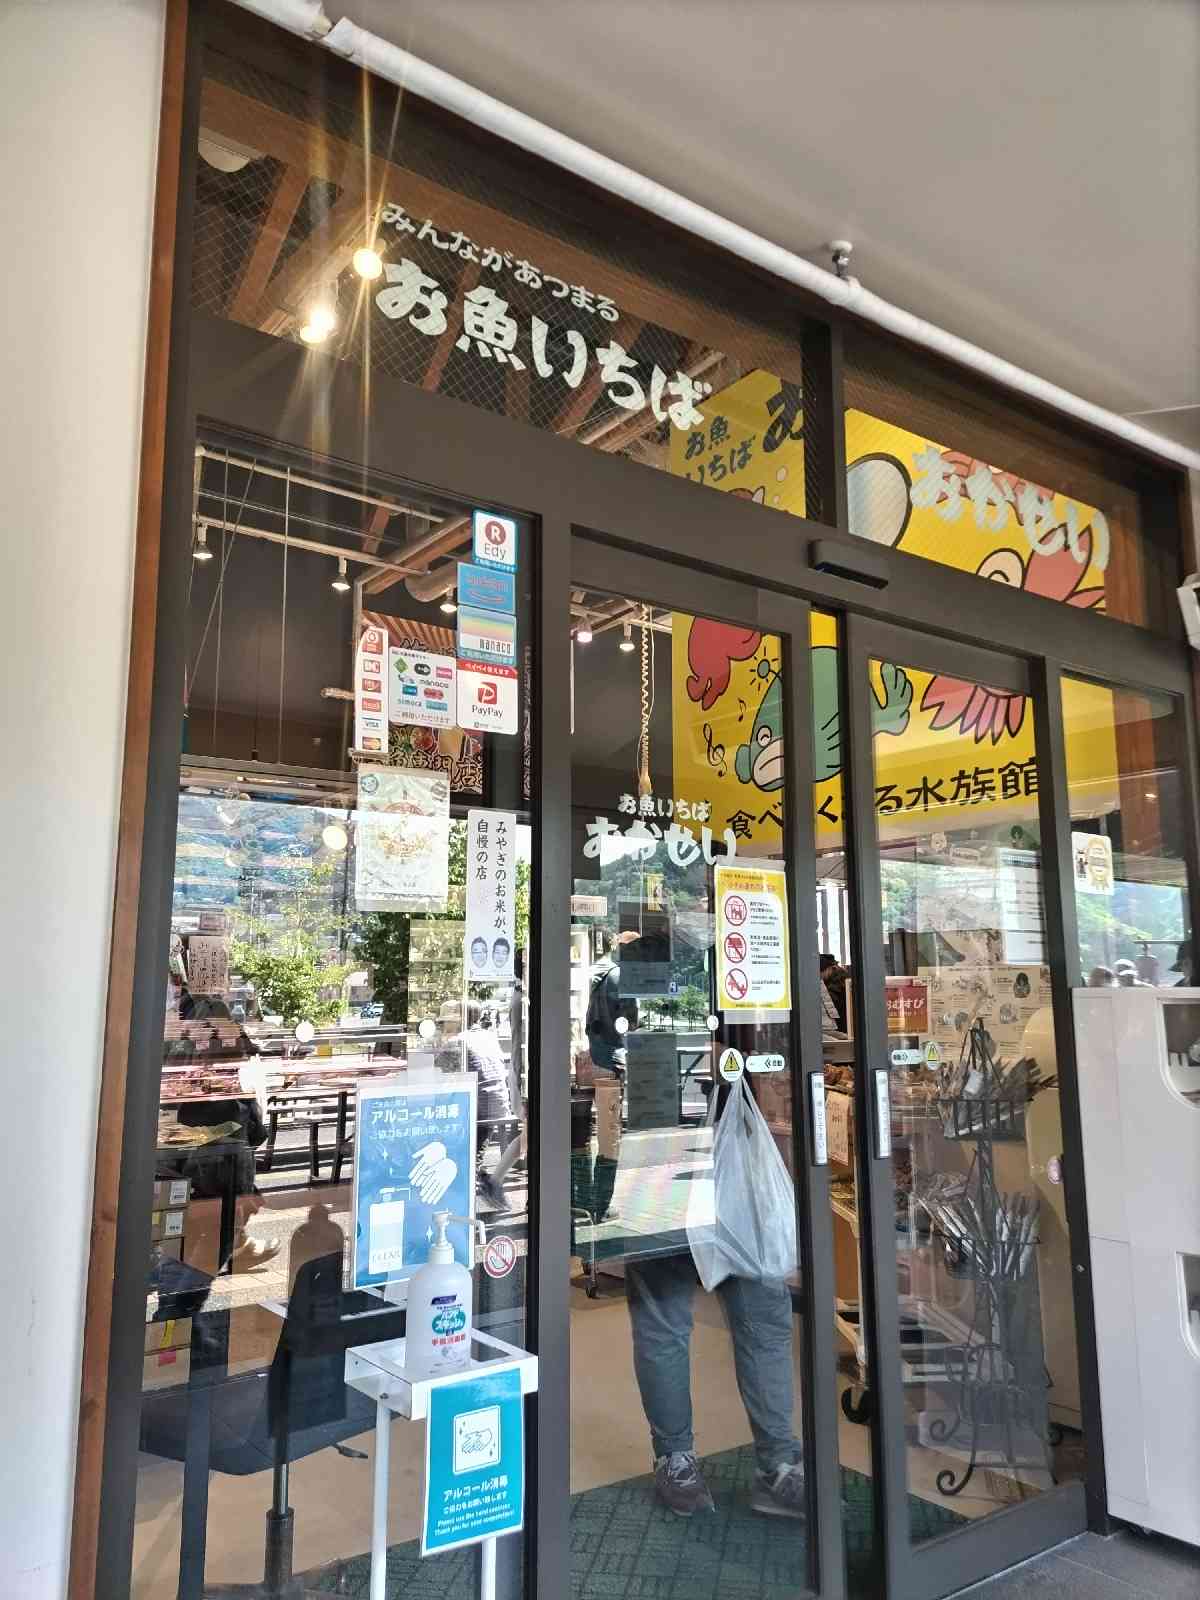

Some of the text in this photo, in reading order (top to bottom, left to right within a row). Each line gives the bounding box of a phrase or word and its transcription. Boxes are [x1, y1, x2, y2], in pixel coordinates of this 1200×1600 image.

[380, 202, 620, 323] みんながあつまる
[375, 257, 713, 431] お魚いちば
[684, 415, 731, 461] お魚
[910, 444, 1111, 574] おかせい
[483, 543, 508, 561] Edy
[471, 703, 503, 719] PayPay
[618, 793, 711, 824] お魚いちば
[475, 818, 489, 881] 自慢の店
[583, 815, 737, 867] おかせい
[494, 820, 508, 936] みやぎのお米が、
[371, 1103, 460, 1125] アルコール消毒
[443, 1475, 509, 1502] アルコール消毒
